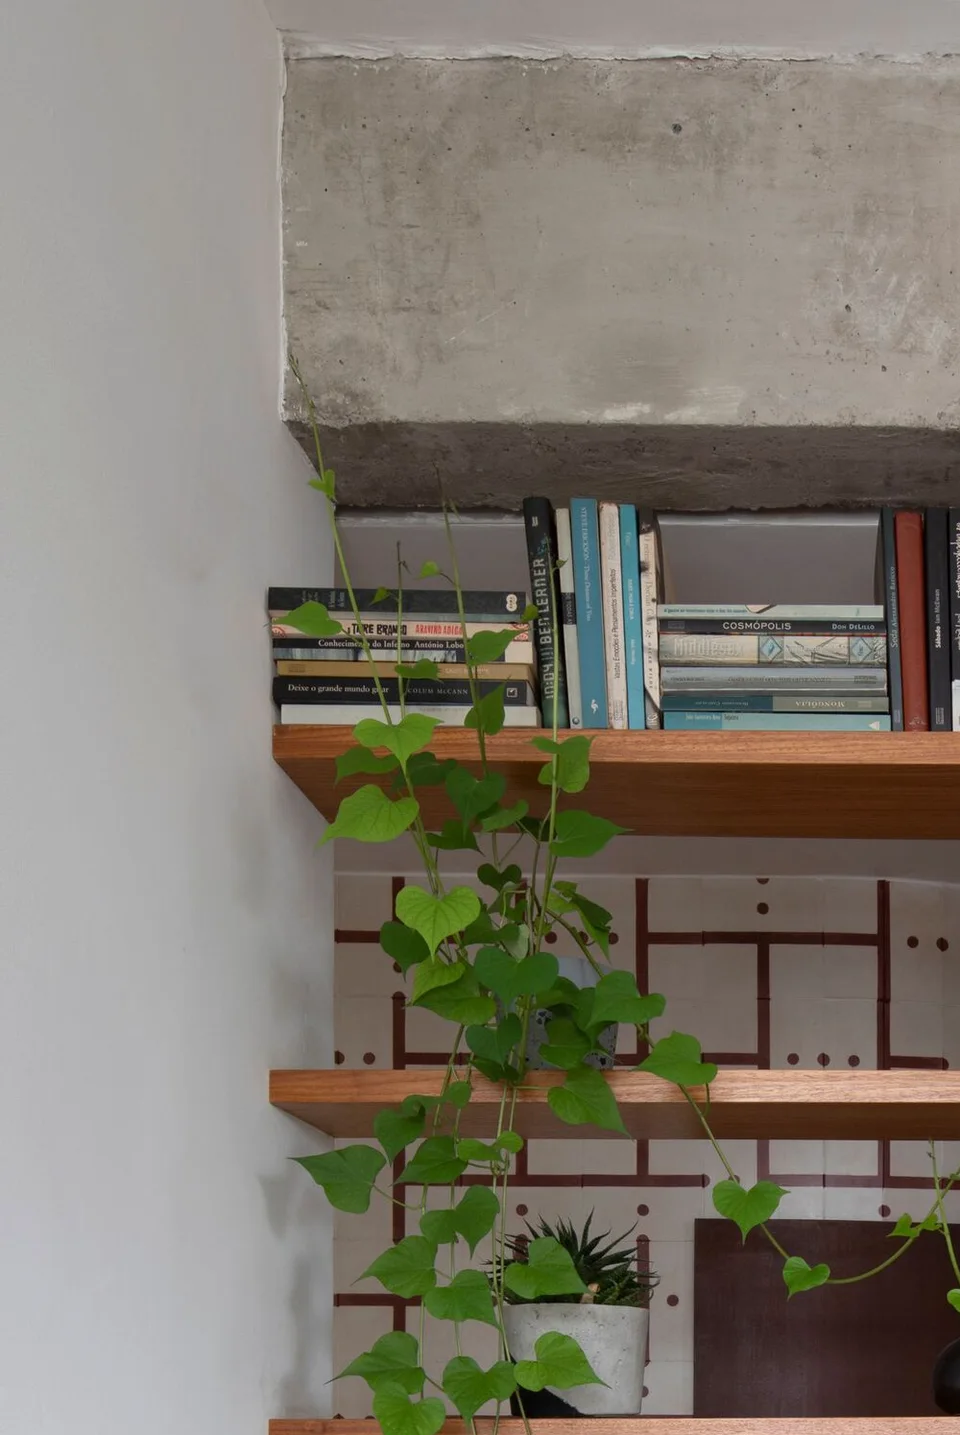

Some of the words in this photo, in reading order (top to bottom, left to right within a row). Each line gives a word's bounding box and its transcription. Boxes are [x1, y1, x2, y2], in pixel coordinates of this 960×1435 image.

[610, 599, 618, 632] Pensamentos
[723, 621, 792, 630] COSMÓPOLIS
[372, 640, 382, 648] do
[890, 629, 898, 648] Seda
[934, 626, 942, 648] Sábado
[318, 685, 342, 693] grande
